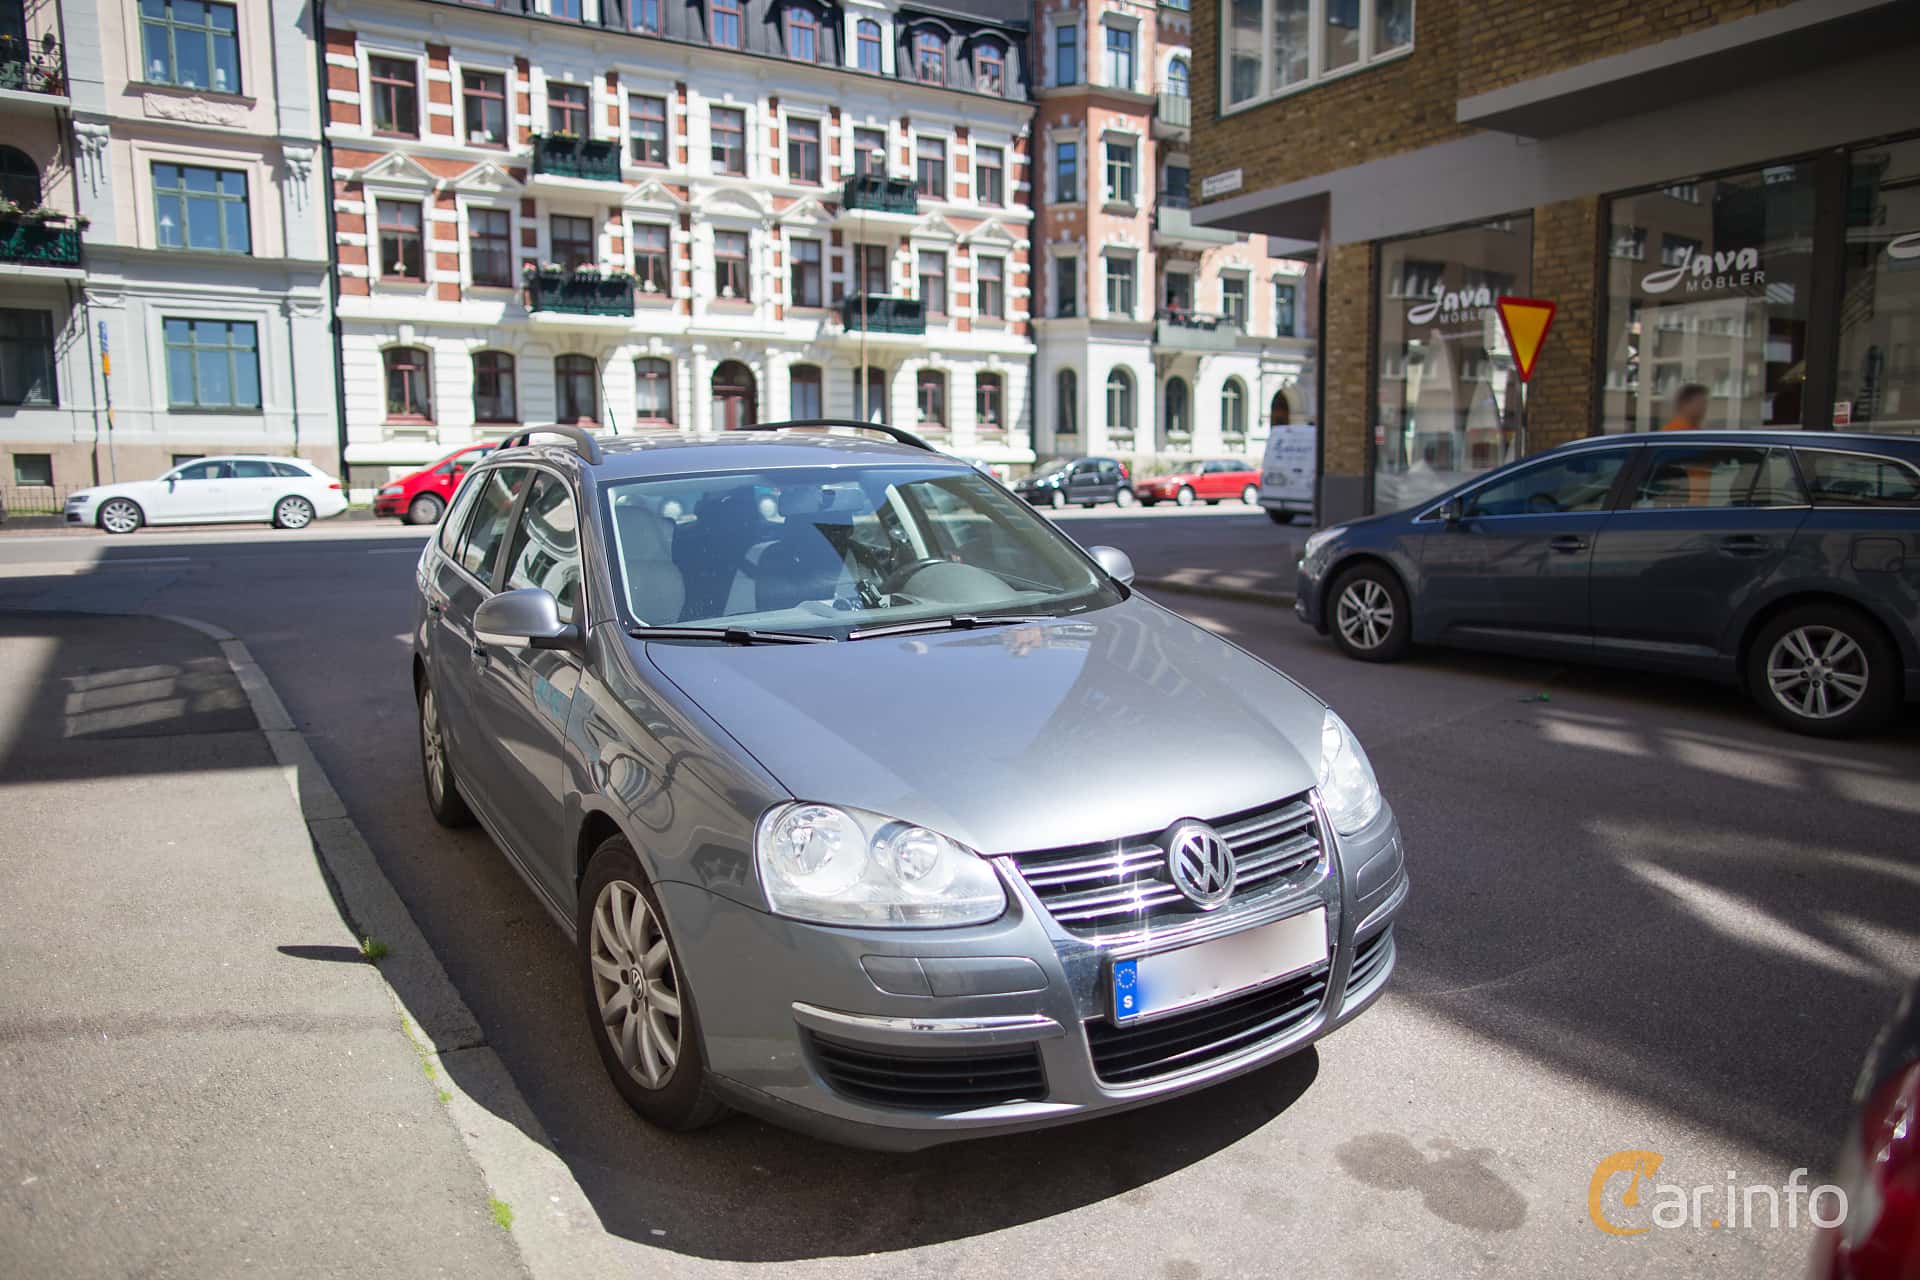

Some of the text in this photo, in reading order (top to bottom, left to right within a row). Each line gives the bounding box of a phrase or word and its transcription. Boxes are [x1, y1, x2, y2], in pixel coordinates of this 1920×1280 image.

[1641, 245, 1758, 293] Java
[1686, 271, 1765, 292] MÖBLER
[1407, 285, 1491, 324] Java
[1122, 995, 1133, 1009] S
